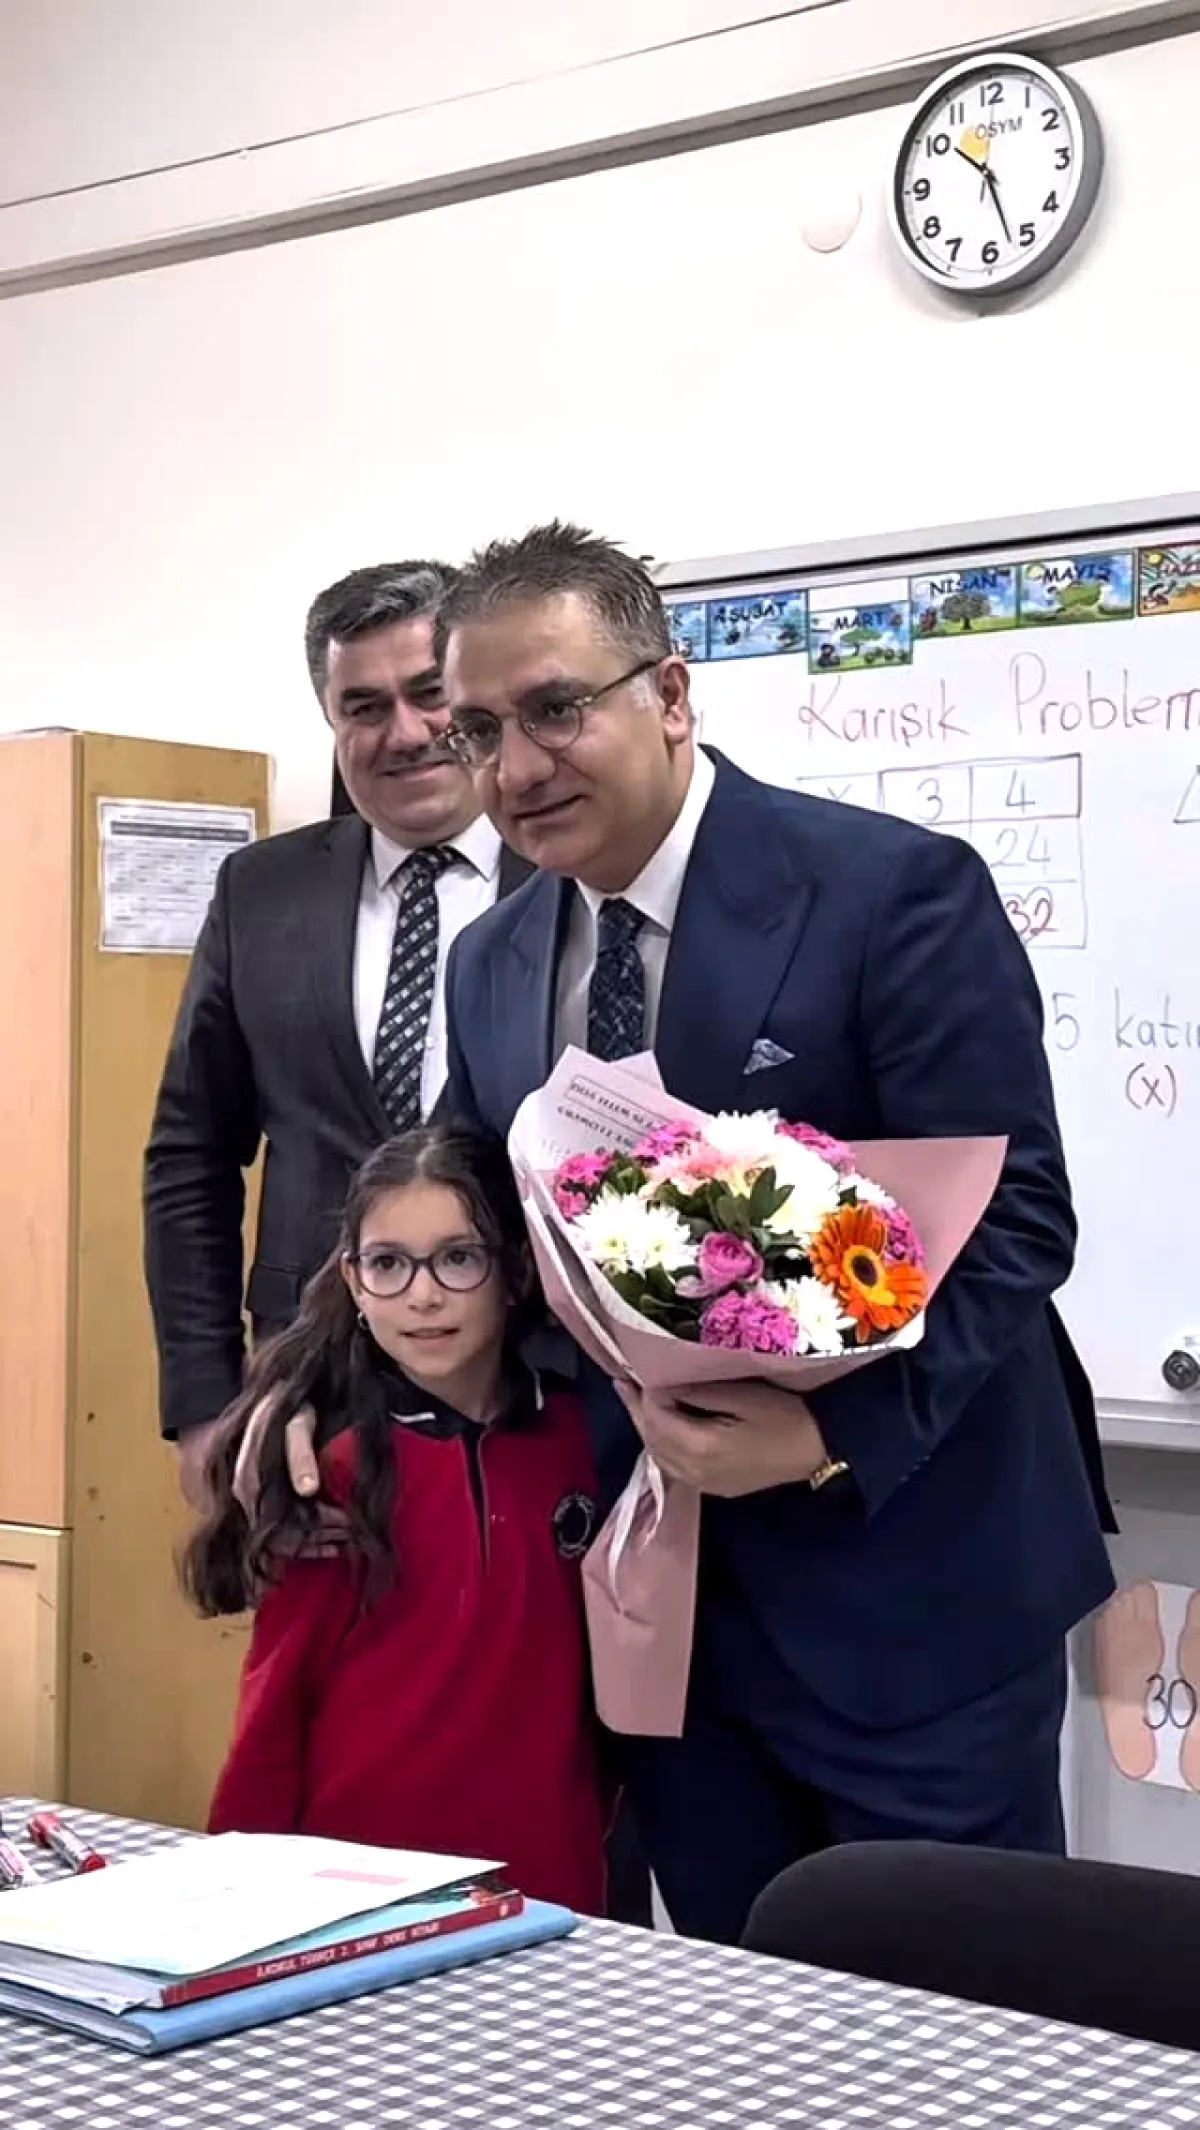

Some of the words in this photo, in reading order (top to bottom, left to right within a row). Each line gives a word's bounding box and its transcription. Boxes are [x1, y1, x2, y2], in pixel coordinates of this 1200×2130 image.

[980, 81, 1004, 108] 12
[1024, 85, 1031, 109] 1
[949, 102, 965, 126] 11
[1041, 107, 1061, 132] 2
[926, 132, 951, 159] 10
[1054, 146, 1071, 170] 3
[912, 177, 931, 202] 9
[1041, 190, 1060, 213] 4
[923, 215, 942, 239] 8
[1019, 222, 1036, 247] 5
[945, 237, 963, 263] 7
[981, 240, 1000, 264] 6
[834, 610, 884, 630] MART
[798, 674, 970, 748] Karışık
[915, 777, 944, 822] 3
[1005, 768, 1036, 815] 4
[990, 823, 1051, 876] 24
[1003, 896, 1060, 938] 32
[1051, 991, 1080, 1051] 5
[1125, 1062, 1177, 1119] (x)
[1142, 1673, 1197, 1730] 30
